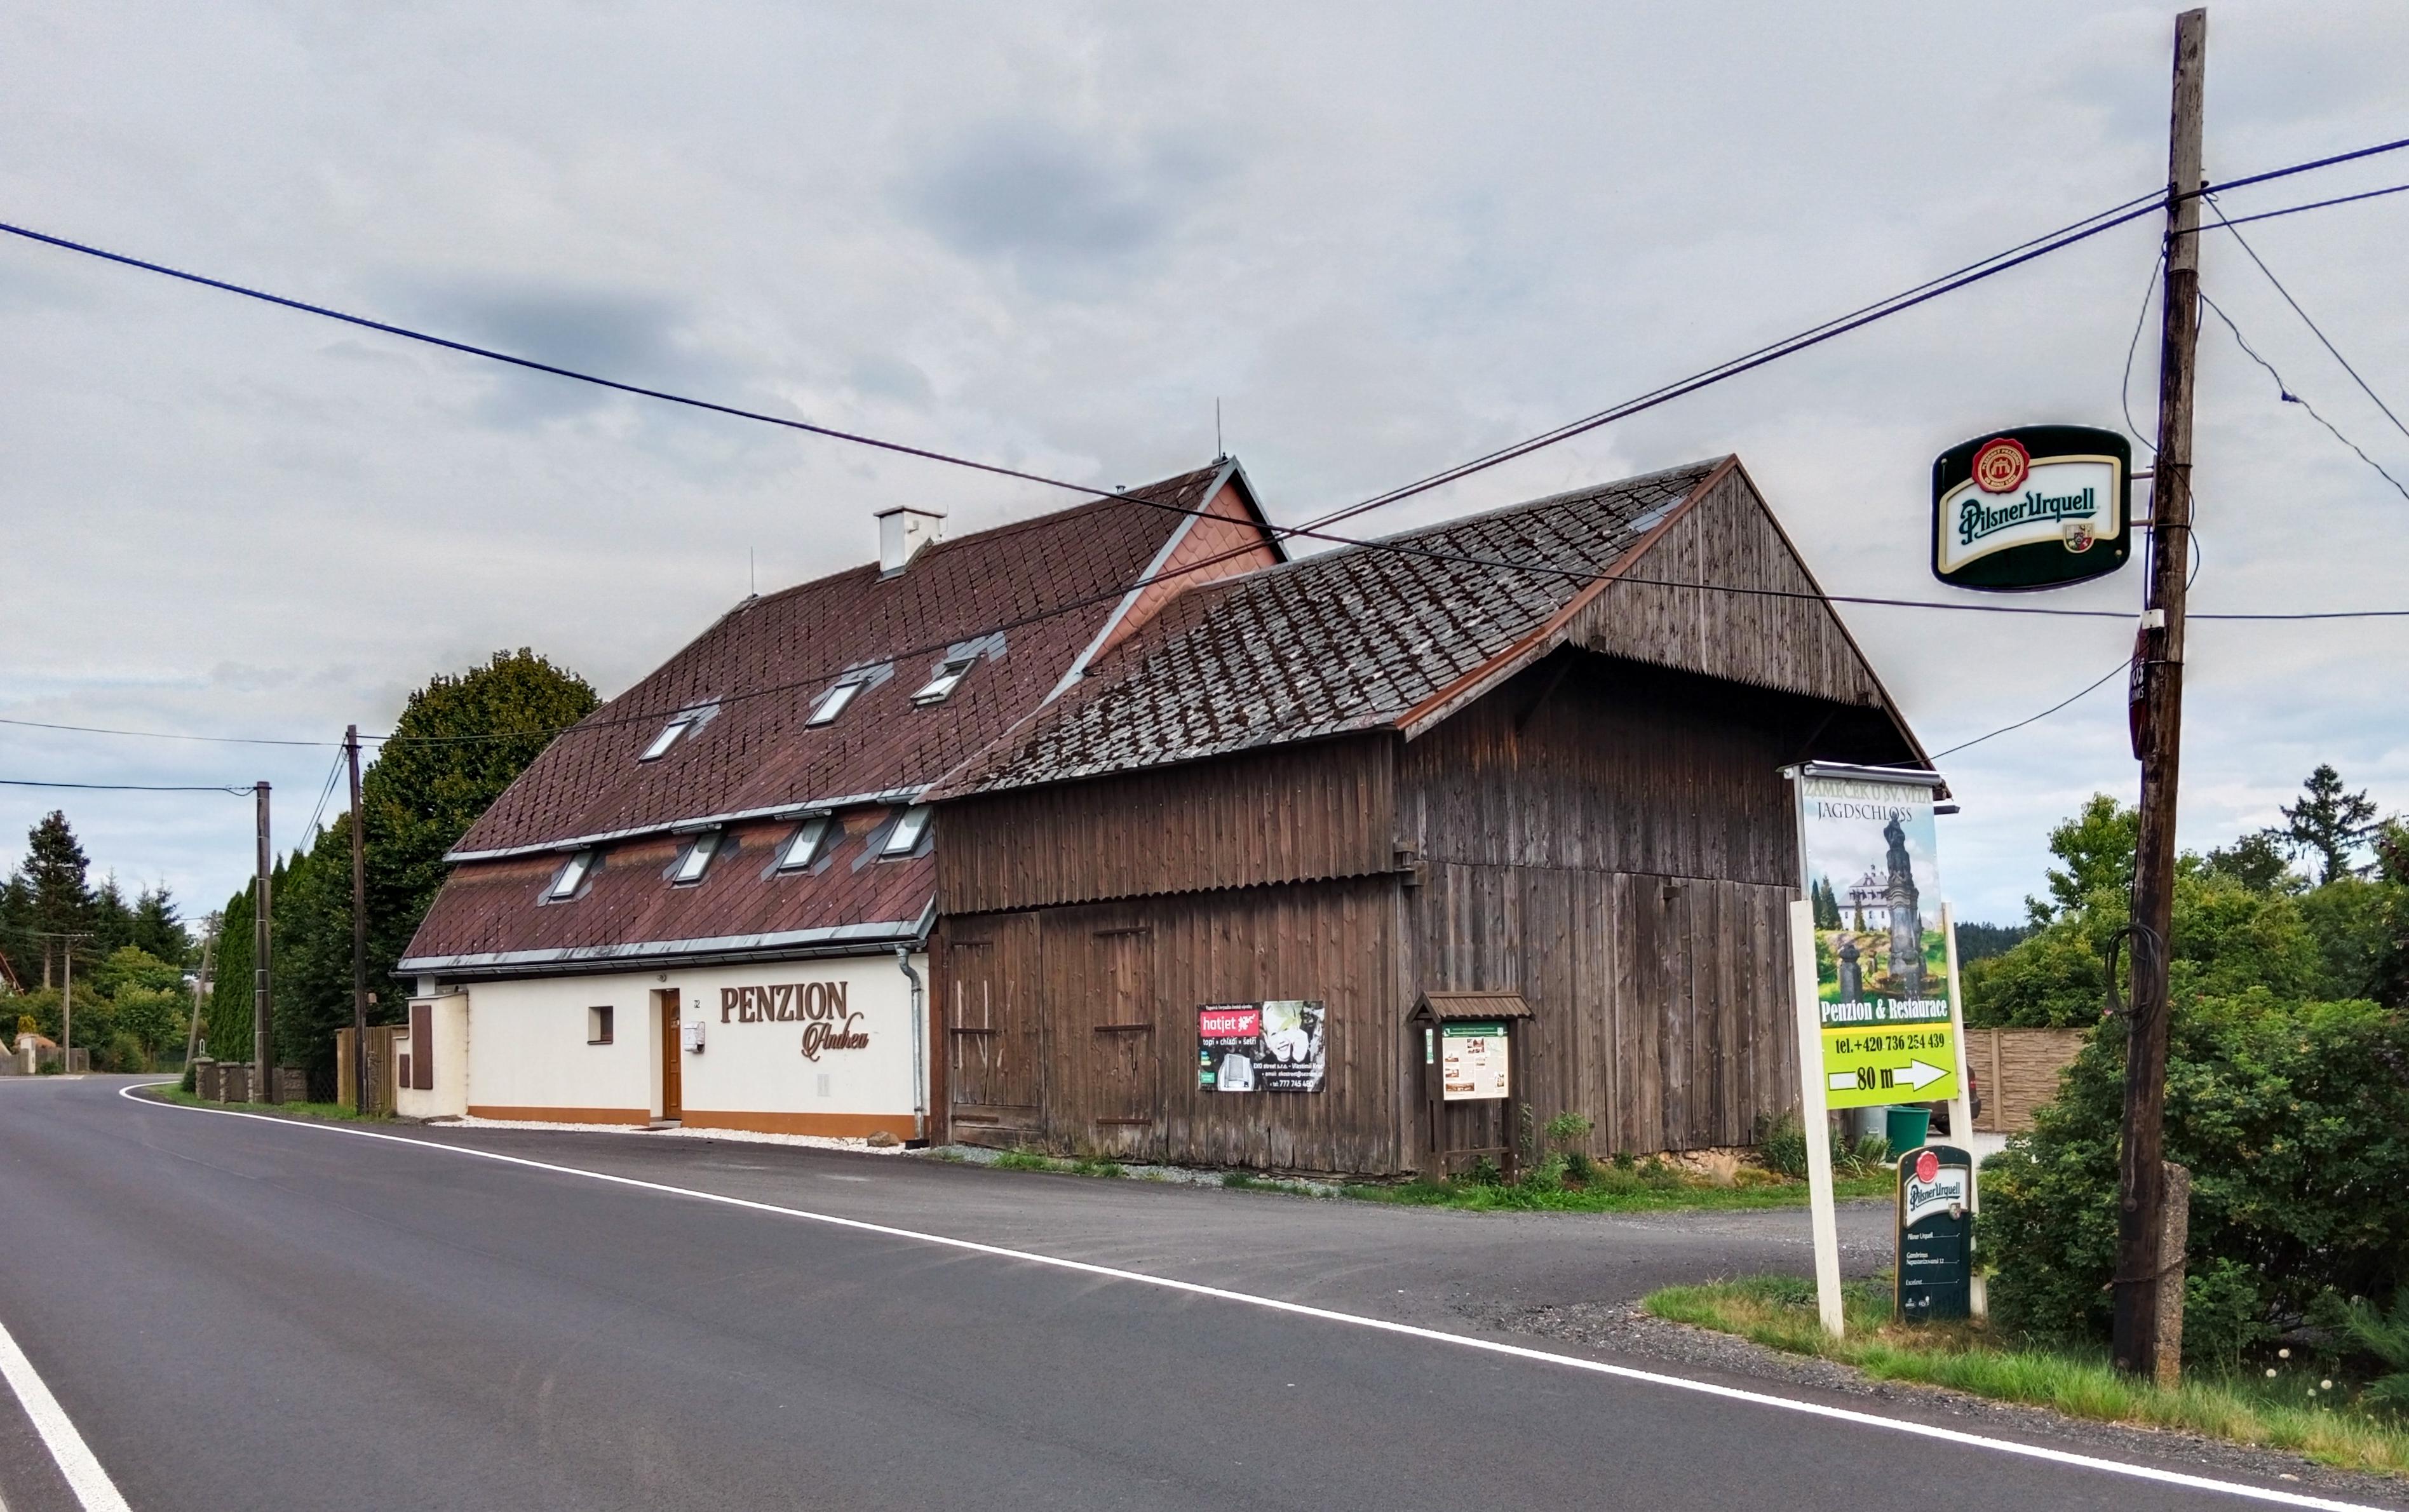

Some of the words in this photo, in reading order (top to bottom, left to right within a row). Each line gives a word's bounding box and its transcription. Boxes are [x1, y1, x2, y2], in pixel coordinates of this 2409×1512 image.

[1959, 499, 2027, 545] Pilsner
[2026, 488, 2094, 523] Urquell
[1818, 802, 1912, 822] JAGDSCHLOSS
[720, 981, 848, 1023] PENZION
[1821, 999, 1873, 1023] Penzion
[1876, 998, 1886, 1020] &
[1887, 997, 1948, 1019] Restaurace
[801, 1011, 869, 1062] Andrea
[1203, 1016, 1236, 1034] hotjet
[1203, 1037, 1215, 1048] topí
[1886, 1035, 1905, 1050] 736
[1907, 1034, 1925, 1050] 254
[1928, 1033, 1945, 1048] 439
[1857, 1066, 1876, 1091] 80
[1880, 1067, 1894, 1089] m
[1910, 1184, 1936, 1212] Pilsner
[1934, 1182, 1960, 1201] Urquell
